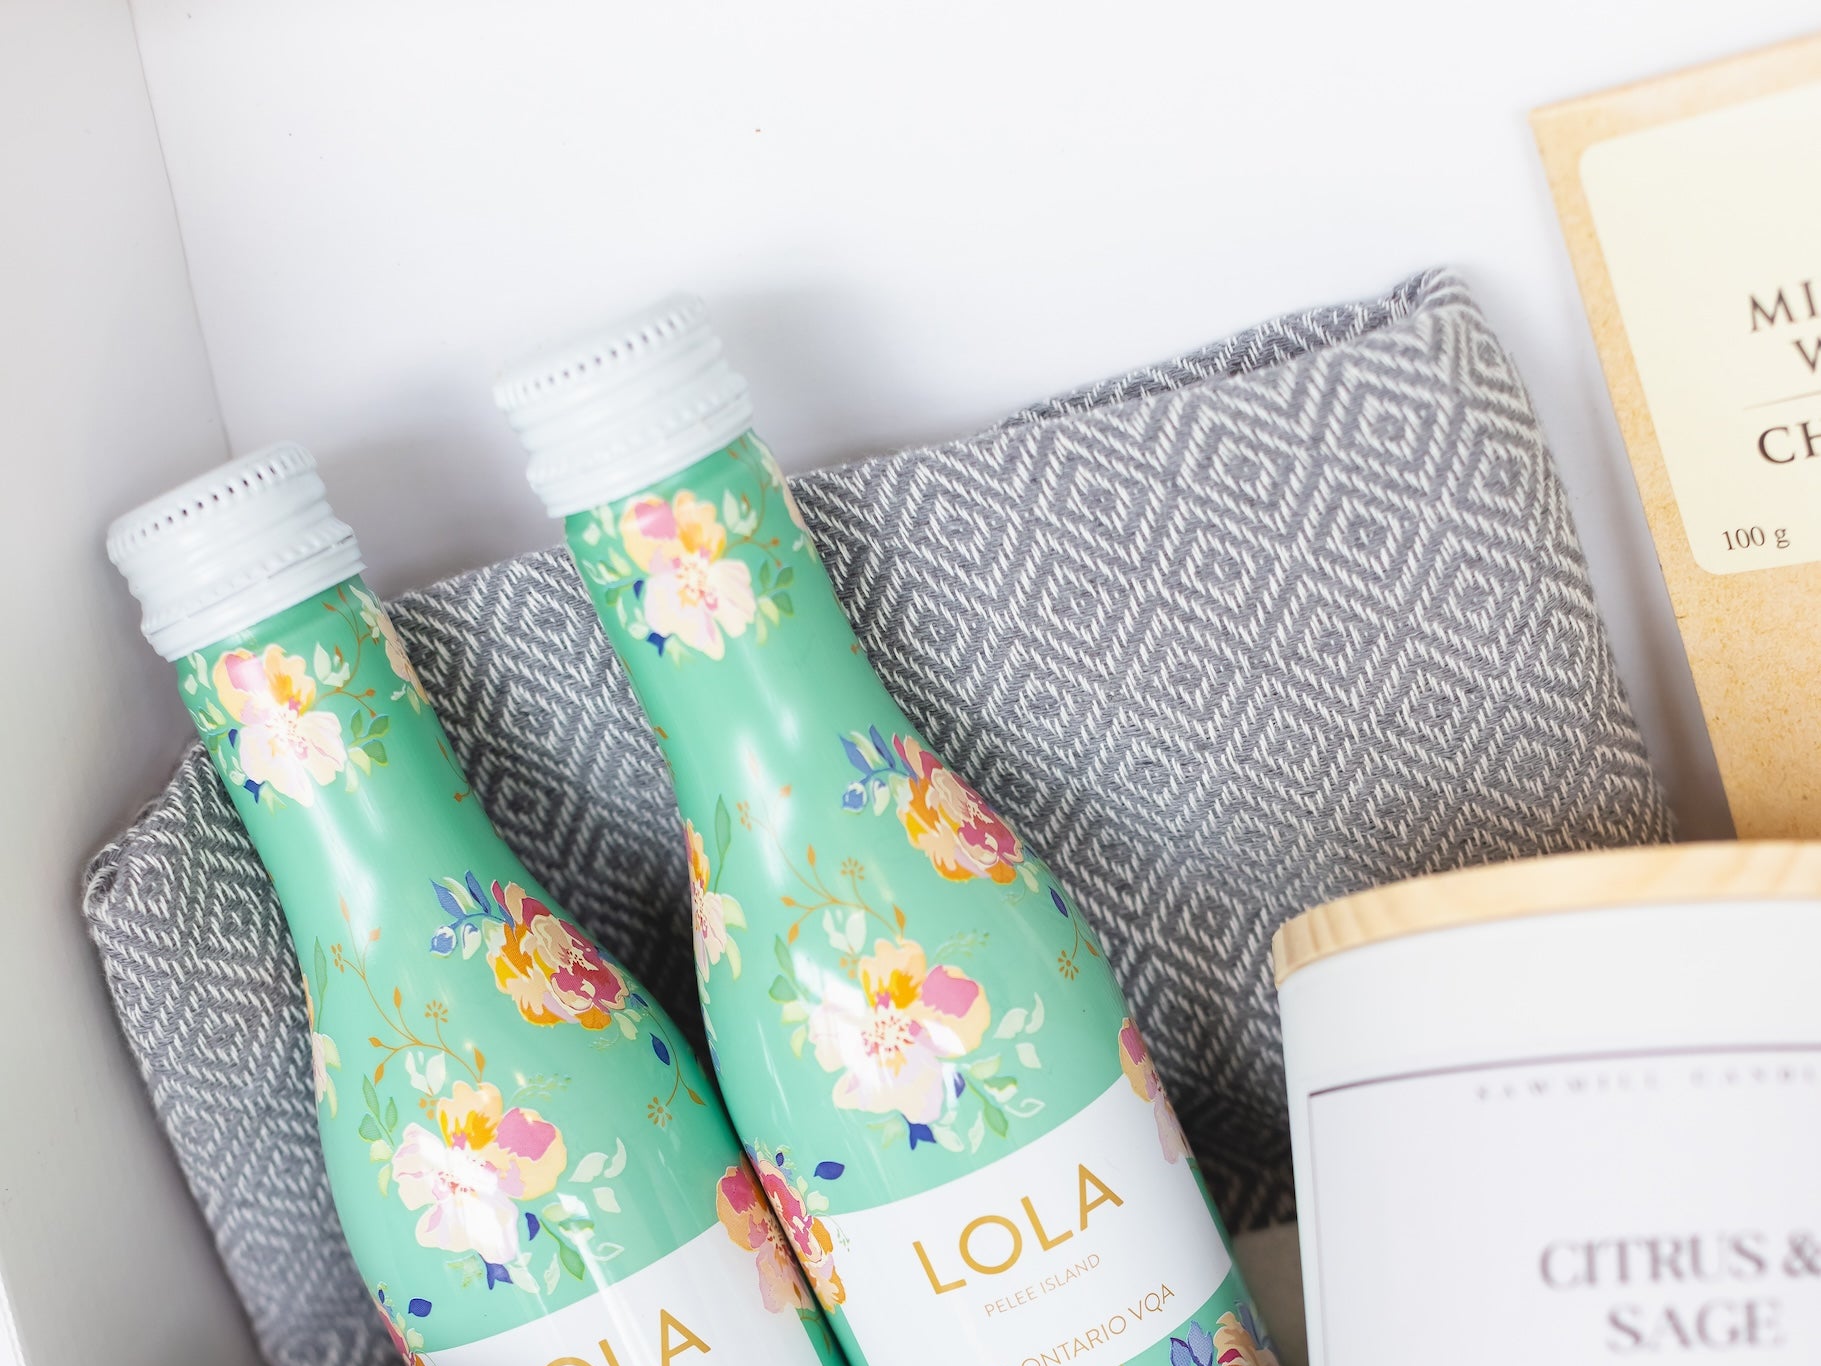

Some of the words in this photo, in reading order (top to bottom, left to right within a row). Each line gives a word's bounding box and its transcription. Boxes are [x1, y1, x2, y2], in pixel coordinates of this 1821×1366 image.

[1721, 526, 1766, 551] 100
[1774, 526, 1790, 549] g
[912, 1163, 1124, 1295] LOLA
[984, 1285, 1038, 1318] PELEE
[1039, 1253, 1101, 1294] ISLAND
[1538, 1232, 1768, 1292] CITRUS
[1781, 1230, 1821, 1278] &
[1128, 1283, 1175, 1321] VQA
[1605, 1298, 1787, 1353] SAGE
